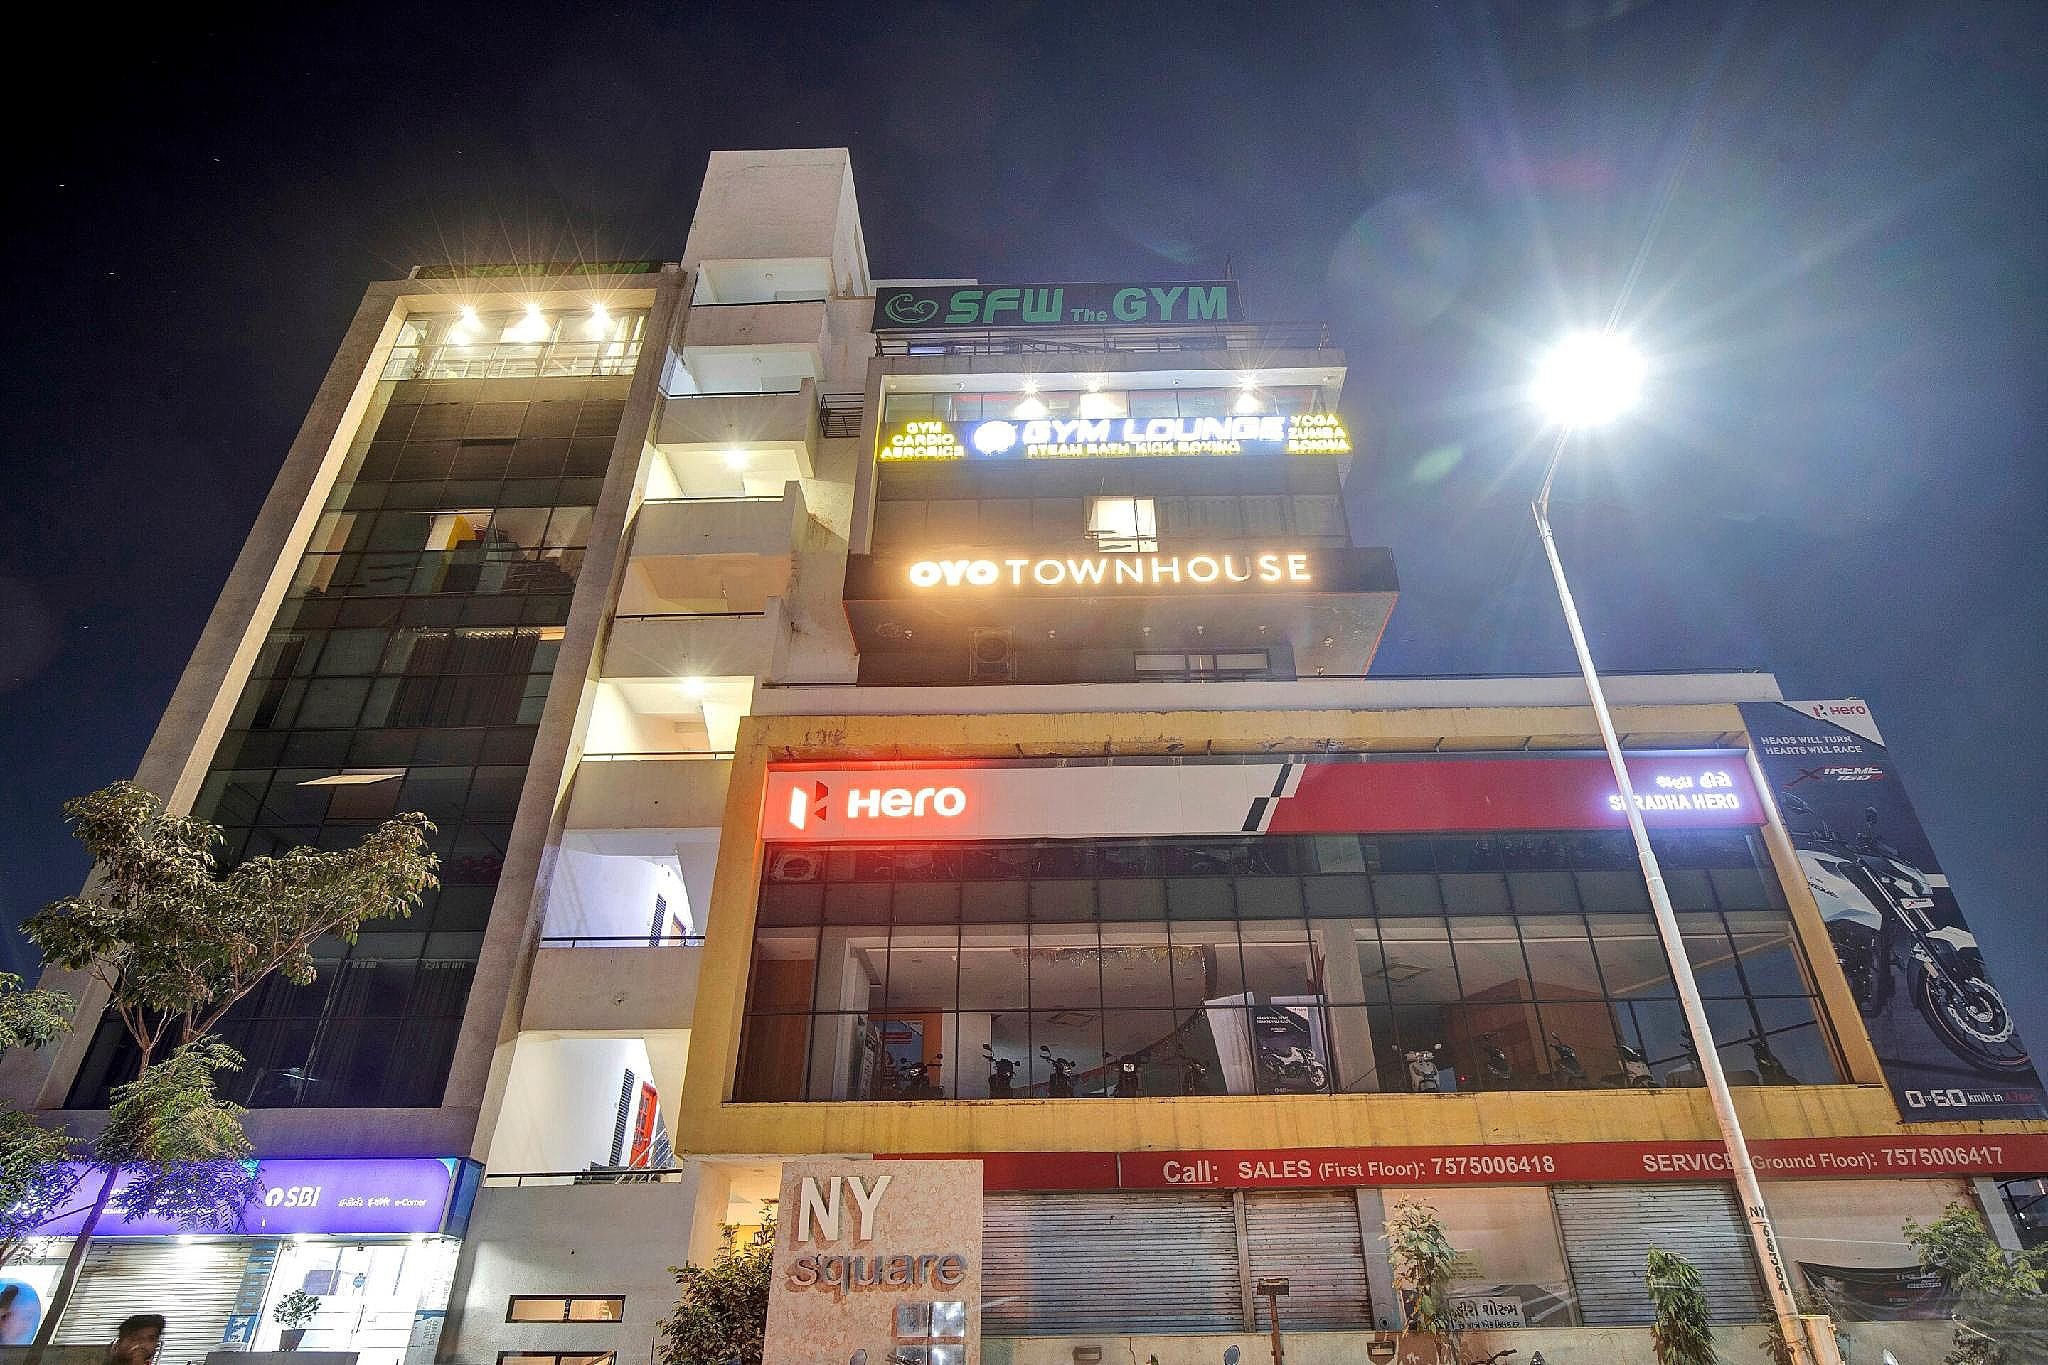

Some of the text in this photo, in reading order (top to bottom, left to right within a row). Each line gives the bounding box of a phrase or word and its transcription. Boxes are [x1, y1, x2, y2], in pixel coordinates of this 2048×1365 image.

[944, 286, 1228, 324] SFW The GYM
[907, 421, 943, 434] GYM
[1022, 416, 1286, 444] GYM LOUNGE
[1290, 414, 1339, 427] YOGA
[892, 433, 955, 446] CARDIO
[909, 555, 1313, 587] OYO TOWNHOUSE
[1829, 705, 1866, 716] Hero
[1760, 735, 1854, 745] HEADS WILL TURN
[1765, 745, 1863, 755] HEARTS WILL RACE
[847, 786, 967, 819] Hero
[1692, 792, 1740, 810] HERO
[1818, 1152, 1878, 1170] Floor):
[1880, 1146, 2003, 1166] 7575006417
[1163, 1155, 1555, 1184] Call: SALES (First Floor): 7575006418
[284, 1186, 322, 1208] SBI
[798, 1175, 892, 1242] NY
[1749, 1206, 1766, 1219] NY
[790, 1253, 968, 1296] square
